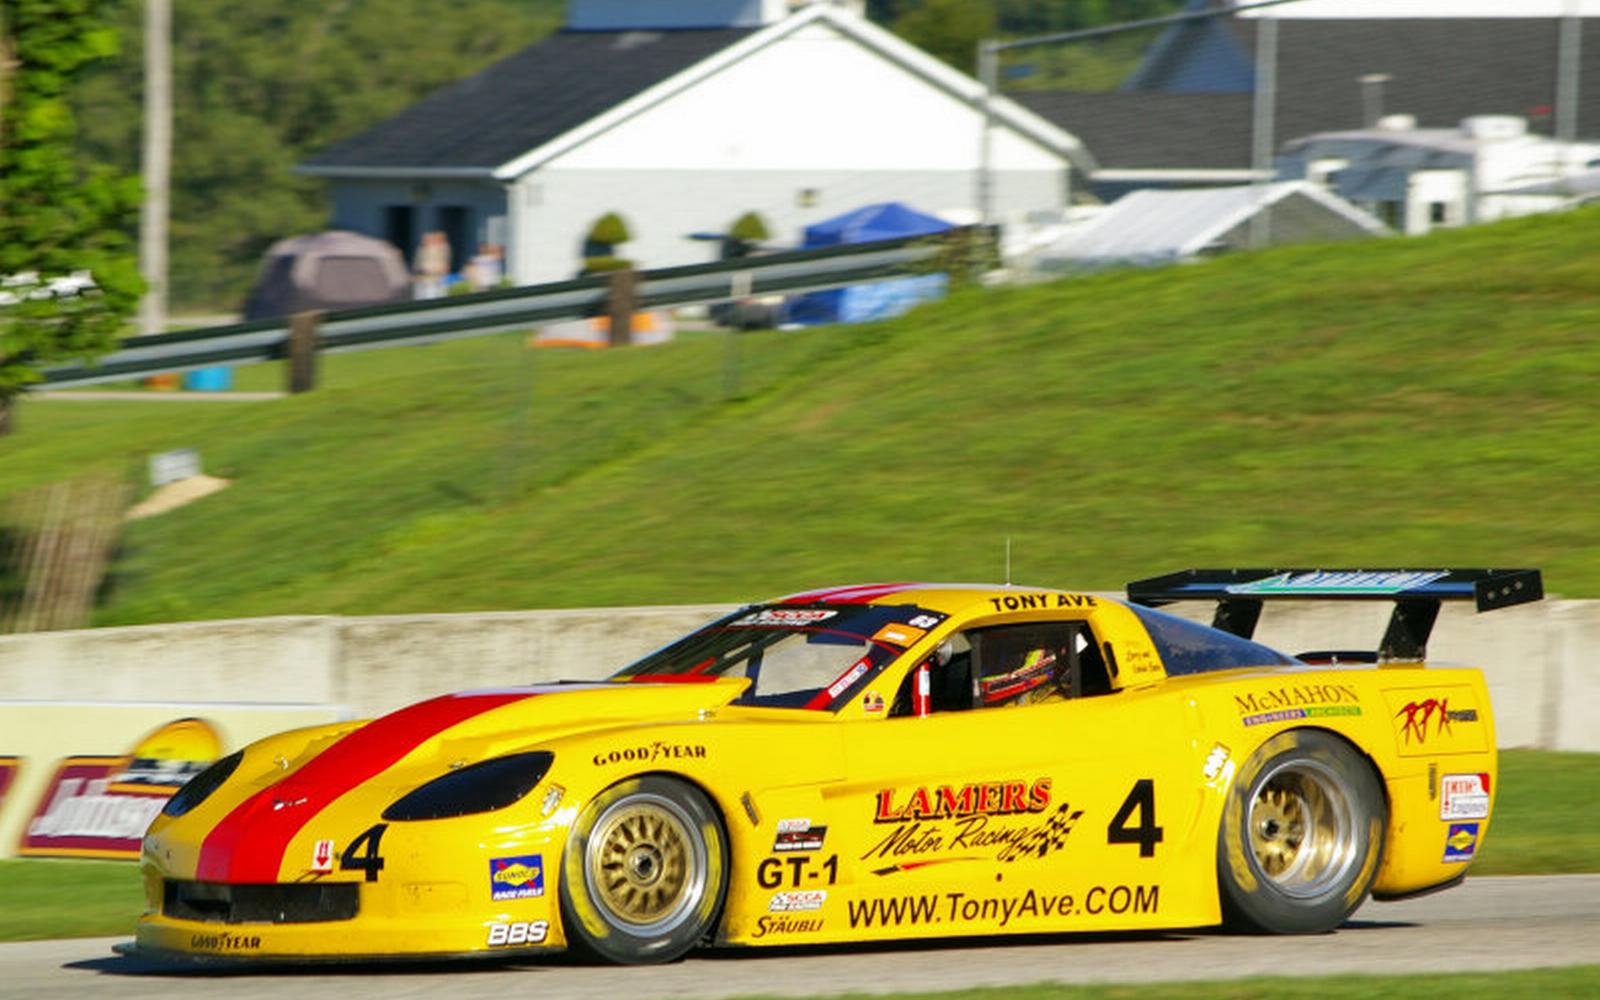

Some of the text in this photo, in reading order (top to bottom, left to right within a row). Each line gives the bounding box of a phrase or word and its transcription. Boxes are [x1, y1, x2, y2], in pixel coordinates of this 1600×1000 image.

[989, 593, 1099, 612] TONY AVE
[1233, 685, 1360, 713] McMAHON
[873, 778, 1052, 824] LAMERS
[1106, 779, 1164, 858] 4
[339, 823, 389, 882] 4
[859, 815, 1031, 861] Motor Racing
[757, 854, 839, 890] GT-1
[847, 885, 1159, 929] WWW.TonyAve.COM
[487, 921, 549, 945] BBS
